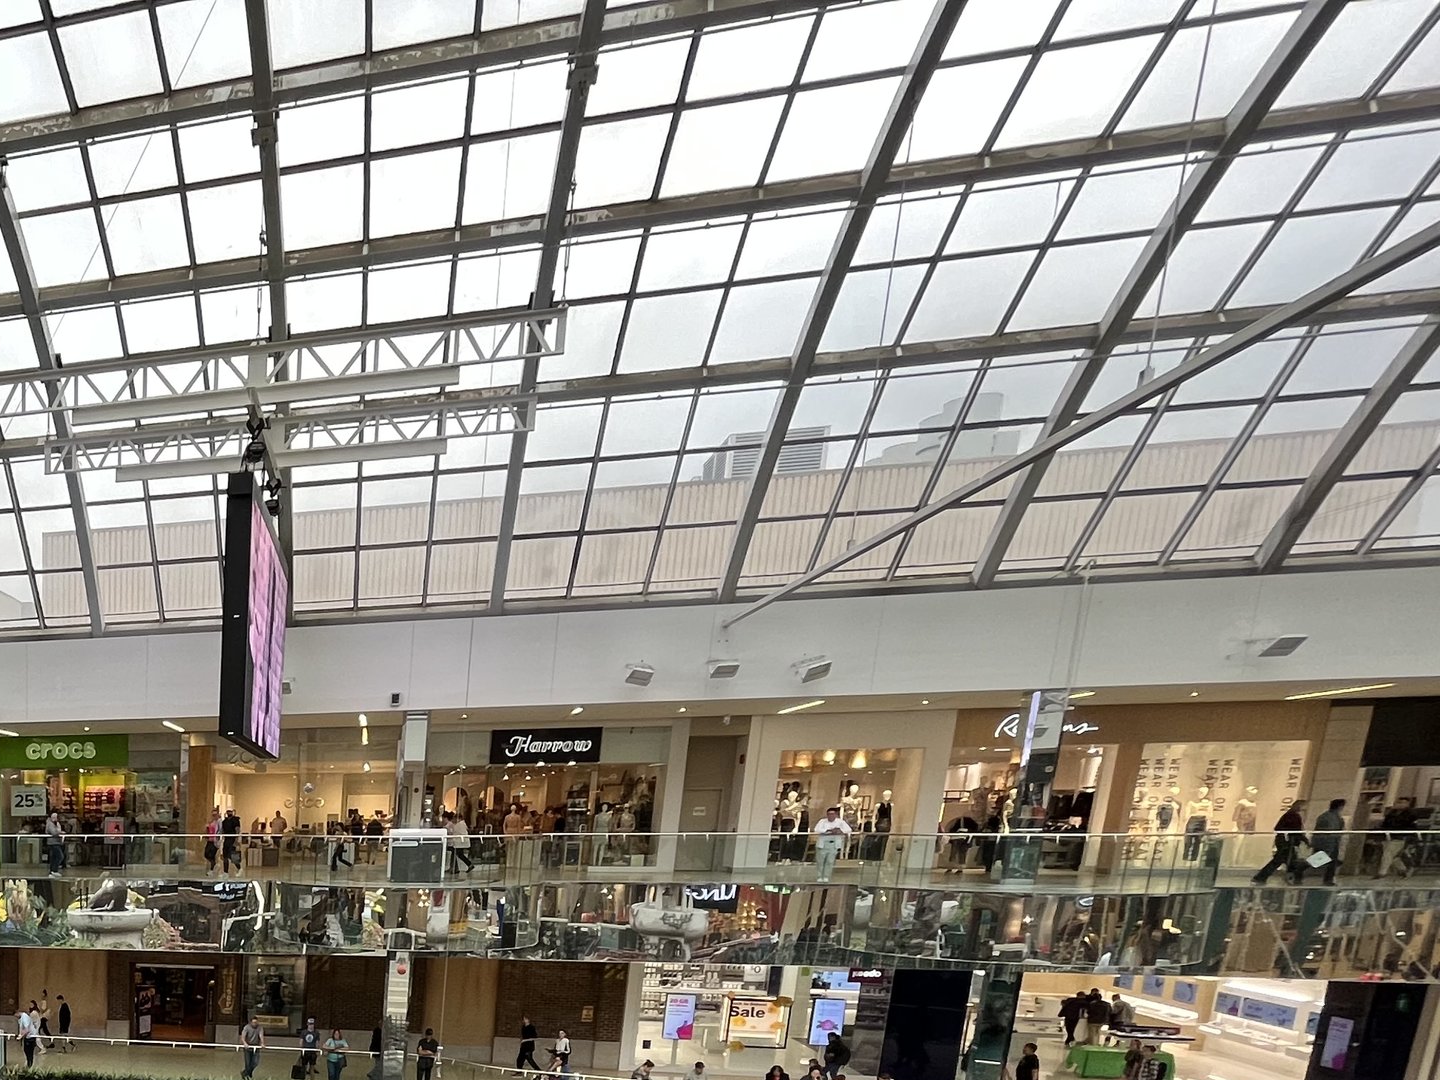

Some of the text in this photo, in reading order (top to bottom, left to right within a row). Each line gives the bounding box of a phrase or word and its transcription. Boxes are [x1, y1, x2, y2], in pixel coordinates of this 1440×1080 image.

[25, 742, 96, 760] crocs
[504, 734, 592, 757] Harrow
[1151, 758, 1165, 788] WEAR
[1166, 757, 1182, 788] WEAR
[1218, 758, 1235, 789] WEAR
[1286, 757, 1303, 789] WEAR
[1213, 797, 1227, 812] ON
[730, 1006, 766, 1018] Sale
